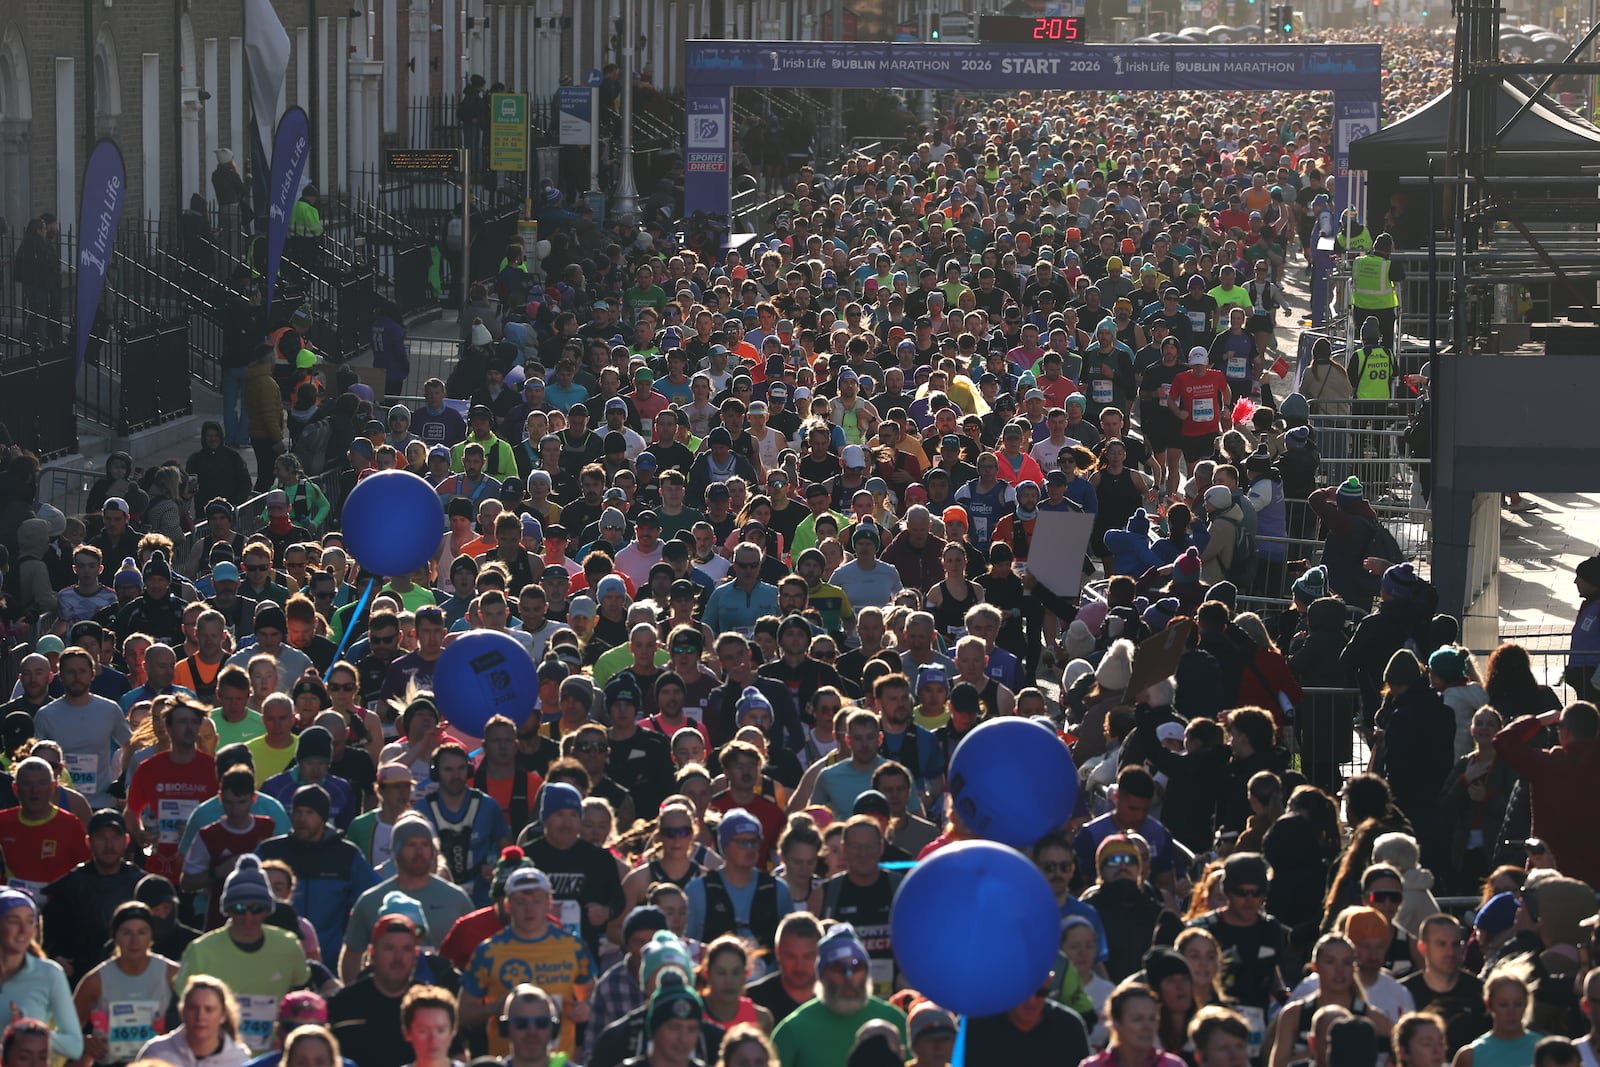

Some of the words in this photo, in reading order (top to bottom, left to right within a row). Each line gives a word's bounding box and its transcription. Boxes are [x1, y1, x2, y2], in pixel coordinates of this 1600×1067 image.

[1033, 18, 1078, 39] 2:05
[782, 58, 804, 69] Irish
[807, 58, 826, 69] Life
[831, 59, 876, 70] DUBLIN
[879, 60, 950, 71] MARATHON
[961, 60, 992, 71] 2026
[1001, 58, 1061, 74] START
[1069, 61, 1101, 72] 2026
[1126, 61, 1148, 72] Irish
[1150, 61, 1170, 72] Life
[1175, 61, 1220, 73] DUBLIN
[1224, 62, 1295, 73] MARATHON
[690, 154, 724, 162] SPORTS
[280, 169, 295, 205] Irish
[290, 136, 306, 168] Life
[94, 211, 112, 254] Irish
[103, 175, 121, 212] Life
[1367, 360, 1388, 369] PHOTO
[1369, 369, 1387, 380] 08
[165, 783, 207, 793] BIOBANK
[535, 960, 573, 973] Marie
[535, 974, 570, 986] Curie
